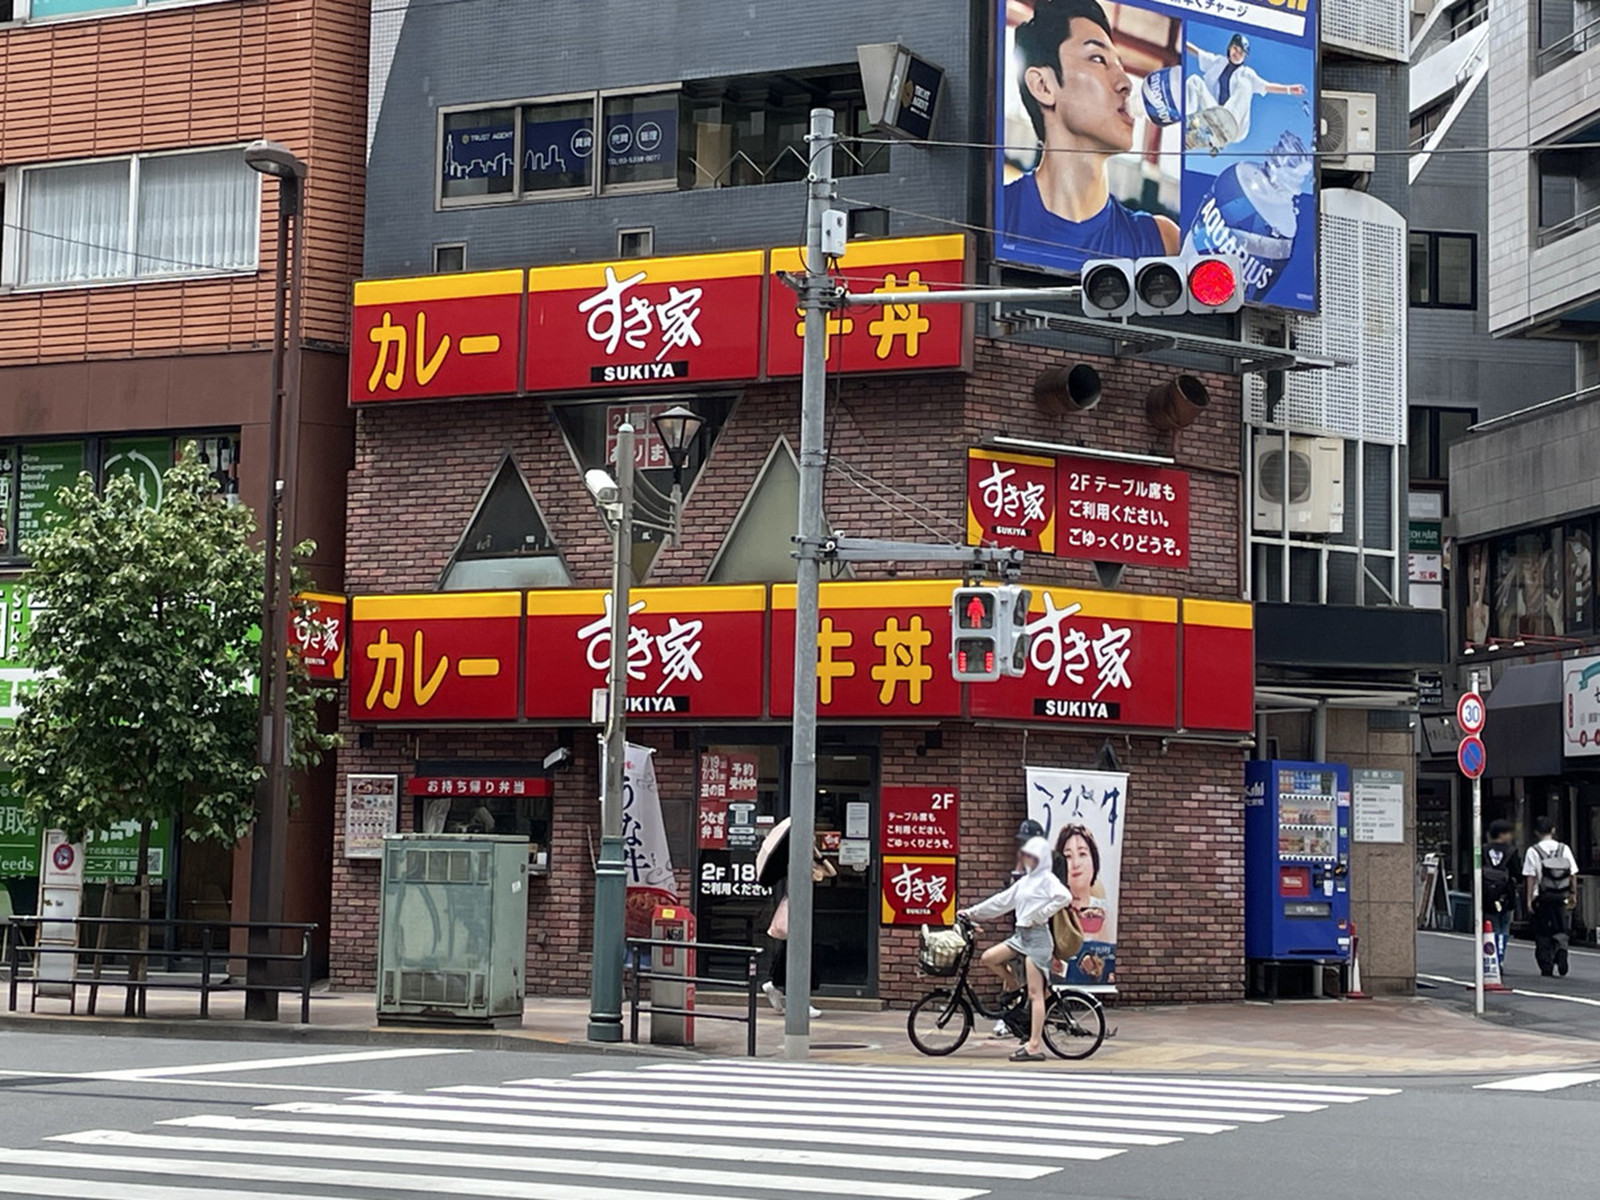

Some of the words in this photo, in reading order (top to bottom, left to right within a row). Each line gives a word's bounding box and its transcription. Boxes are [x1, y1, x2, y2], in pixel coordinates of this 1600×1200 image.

[1201, 198, 1272, 289] AQUARIUS
[578, 266, 702, 361] すき家
[368, 311, 500, 392] カレー
[603, 364, 675, 381] SUKIYA
[21, 464, 63, 472] Champagne
[21, 473, 45, 481] Brandy
[979, 462, 1045, 526] すき家
[1070, 474, 1091, 491] 2F
[1095, 476, 1175, 501] テーブル席も
[1069, 500, 1169, 527] ご利用ください。
[996, 526, 1027, 537] SUKIYA
[1069, 528, 1181, 556] ごゆっくりどうぞ。
[577, 594, 703, 694] すき家
[1027, 591, 1132, 699] すき家
[366, 627, 500, 710] カレー
[1045, 700, 1109, 719] SUKIYA
[1465, 705, 1480, 723] 30
[732, 763, 754, 777] 予約
[427, 780, 525, 794] お持ち帰り弁当
[701, 784, 726, 798] 丑の日
[729, 777, 757, 791] 受付中
[932, 793, 955, 810] 2F
[699, 811, 727, 825] うなぎ
[888, 812, 936, 822] テーブル席も
[701, 825, 724, 839] 弁当
[887, 825, 946, 835] ご利用ください。
[887, 838, 954, 849] ごゆっくりどうぞ。
[1, 856, 34, 870] eeds
[702, 863, 726, 881] 2F
[701, 882, 773, 896] ご利用ください
[891, 863, 947, 907] すき家
